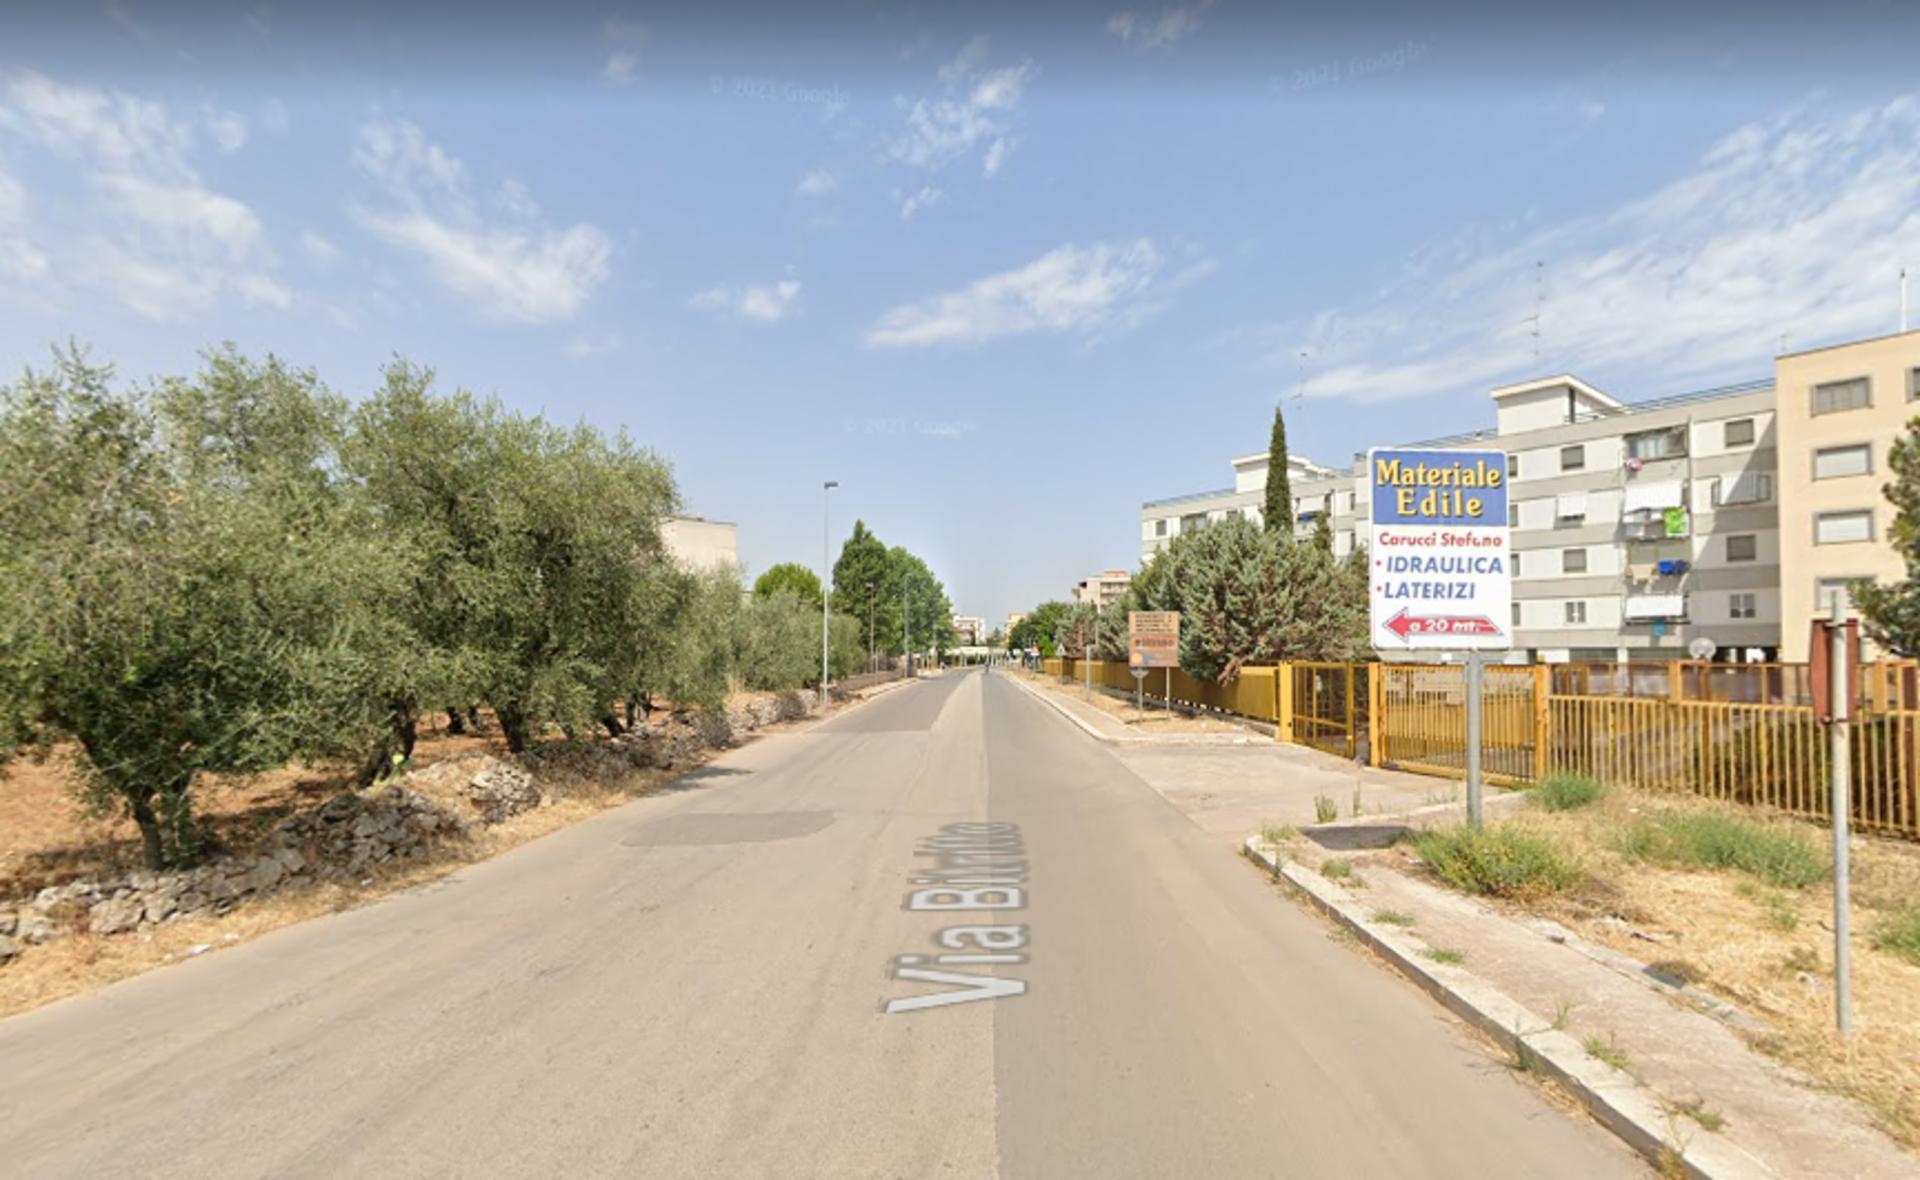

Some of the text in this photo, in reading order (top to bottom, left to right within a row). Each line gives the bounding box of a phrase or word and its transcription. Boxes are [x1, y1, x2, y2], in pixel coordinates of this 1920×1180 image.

[1376, 459, 1503, 488] Materiale
[1397, 489, 1484, 518] Edile
[1379, 531, 1437, 547] Carucci
[1386, 556, 1504, 574] IDRAULICA
[1384, 581, 1476, 599] LATERIZI
[1409, 621, 1421, 632] a
[1426, 619, 1449, 632] 20
